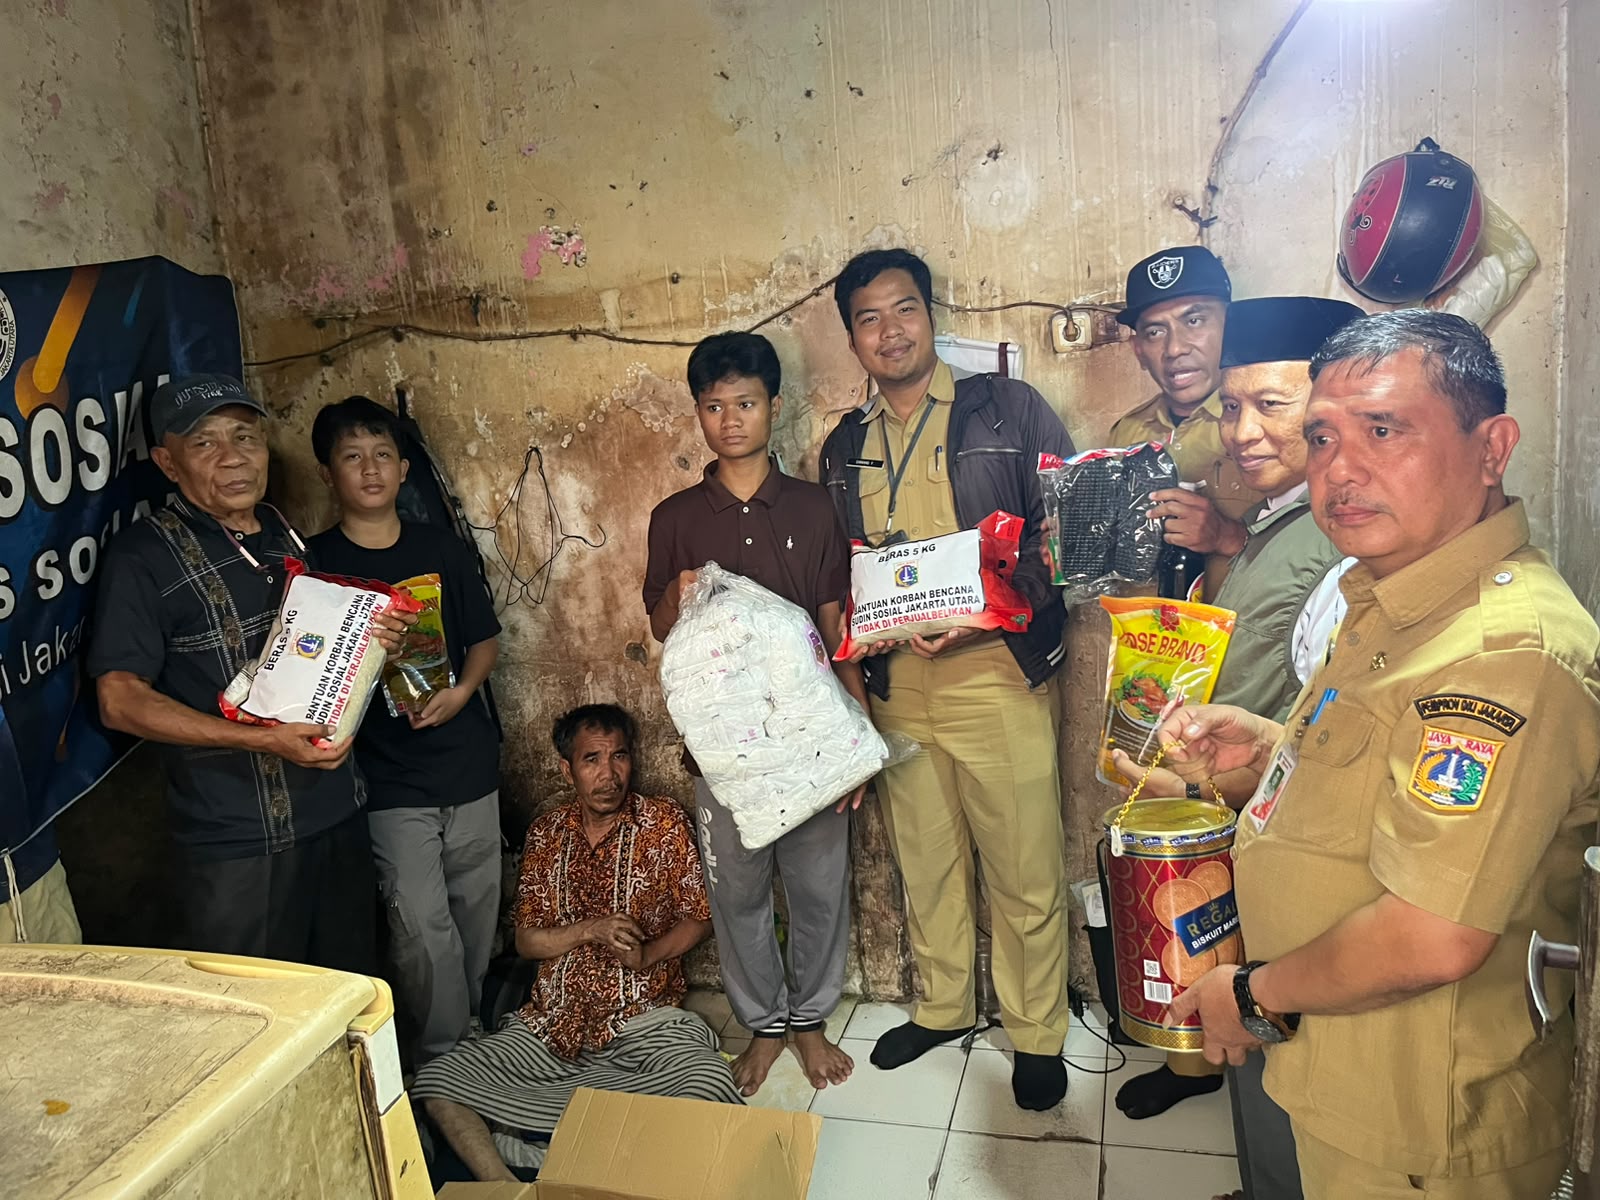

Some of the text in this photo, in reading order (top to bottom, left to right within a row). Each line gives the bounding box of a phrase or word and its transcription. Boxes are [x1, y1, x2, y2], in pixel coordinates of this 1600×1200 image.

[0, 374, 170, 518] SOSIA
[878, 549, 910, 564] BERAS
[912, 547, 919, 556] 5
[921, 543, 936, 555] KG
[890, 591, 927, 605] KORBAN
[929, 585, 974, 599] BENCANA
[852, 595, 981, 626] SUDIN SOSIAL JAKARTA UTARA
[857, 607, 972, 634] TIDAK DI PERJUALBELIKAN
[264, 636, 287, 671] BERAS
[285, 609, 298, 625] KG
[1159, 635, 1206, 664] BRAND
[306, 594, 365, 720] BANTUAN KORBAN BENCANA
[315, 700, 333, 725] UDIN
[327, 666, 347, 699] SOSIAL
[358, 593, 378, 619] UTARA
[327, 696, 346, 725] TIDAK
[340, 683, 351, 694] DI
[1460, 699, 1477, 713] DKI
[1428, 731, 1495, 756] JAYA RAYA
[1191, 926, 1223, 949] BISKUIT
